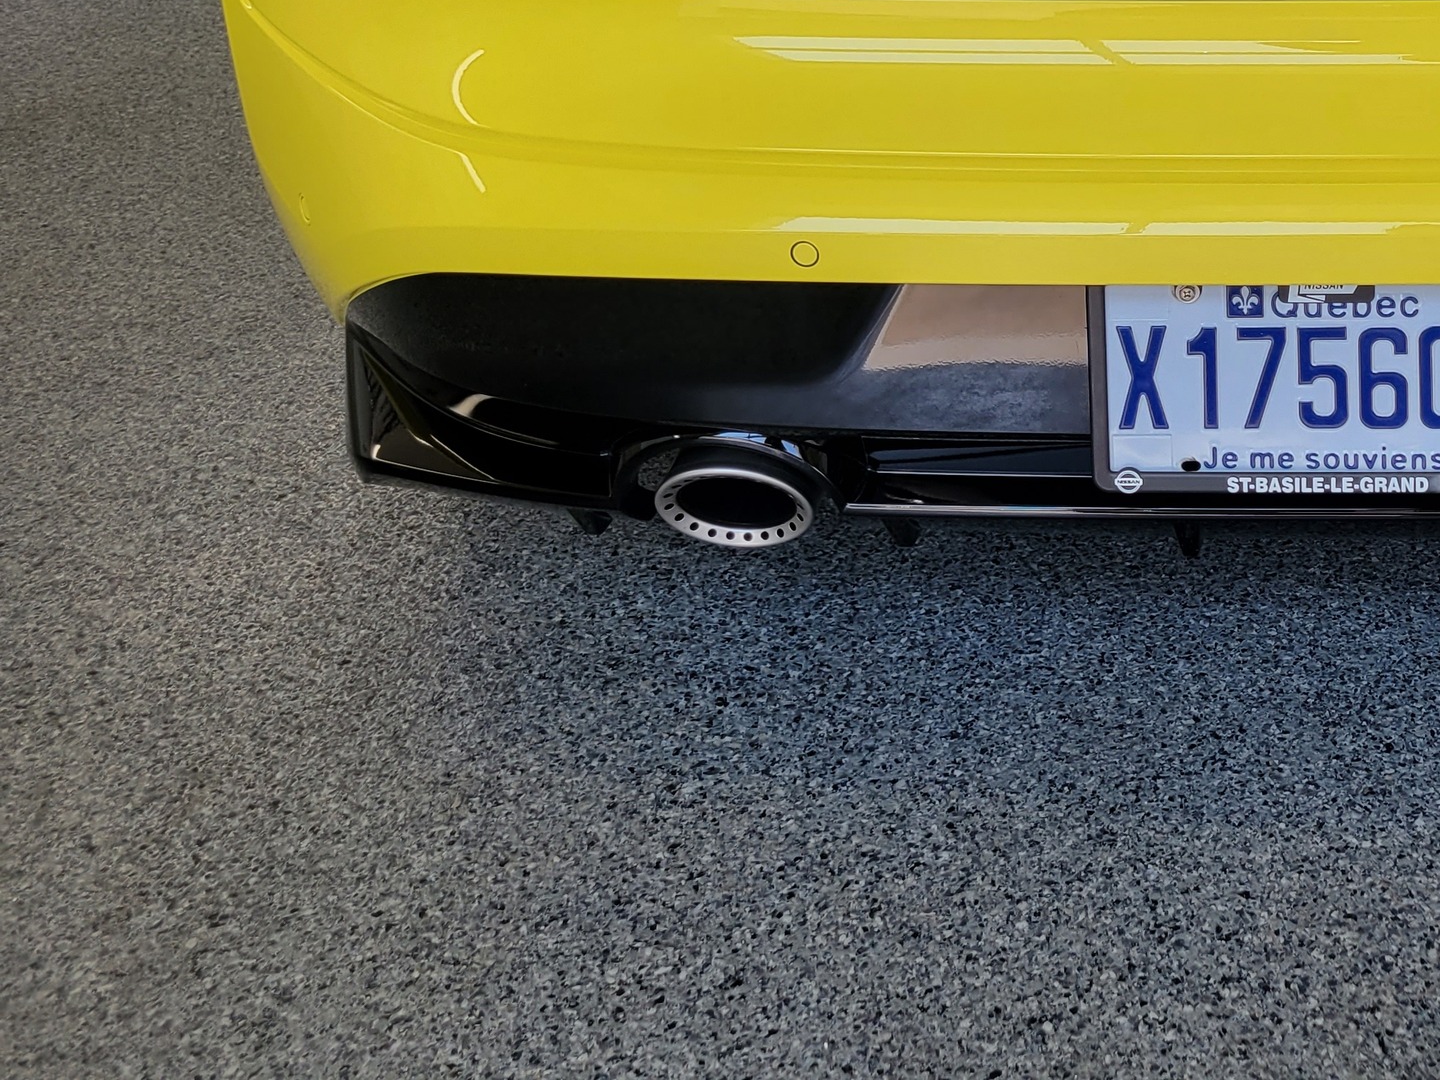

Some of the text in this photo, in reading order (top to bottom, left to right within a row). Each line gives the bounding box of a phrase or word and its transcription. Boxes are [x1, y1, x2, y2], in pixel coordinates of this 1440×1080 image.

[1203, 446, 1239, 469] Je
[1250, 451, 1294, 469] me
[1227, 476, 1429, 493] ST-BASILE-LE-GRAND
